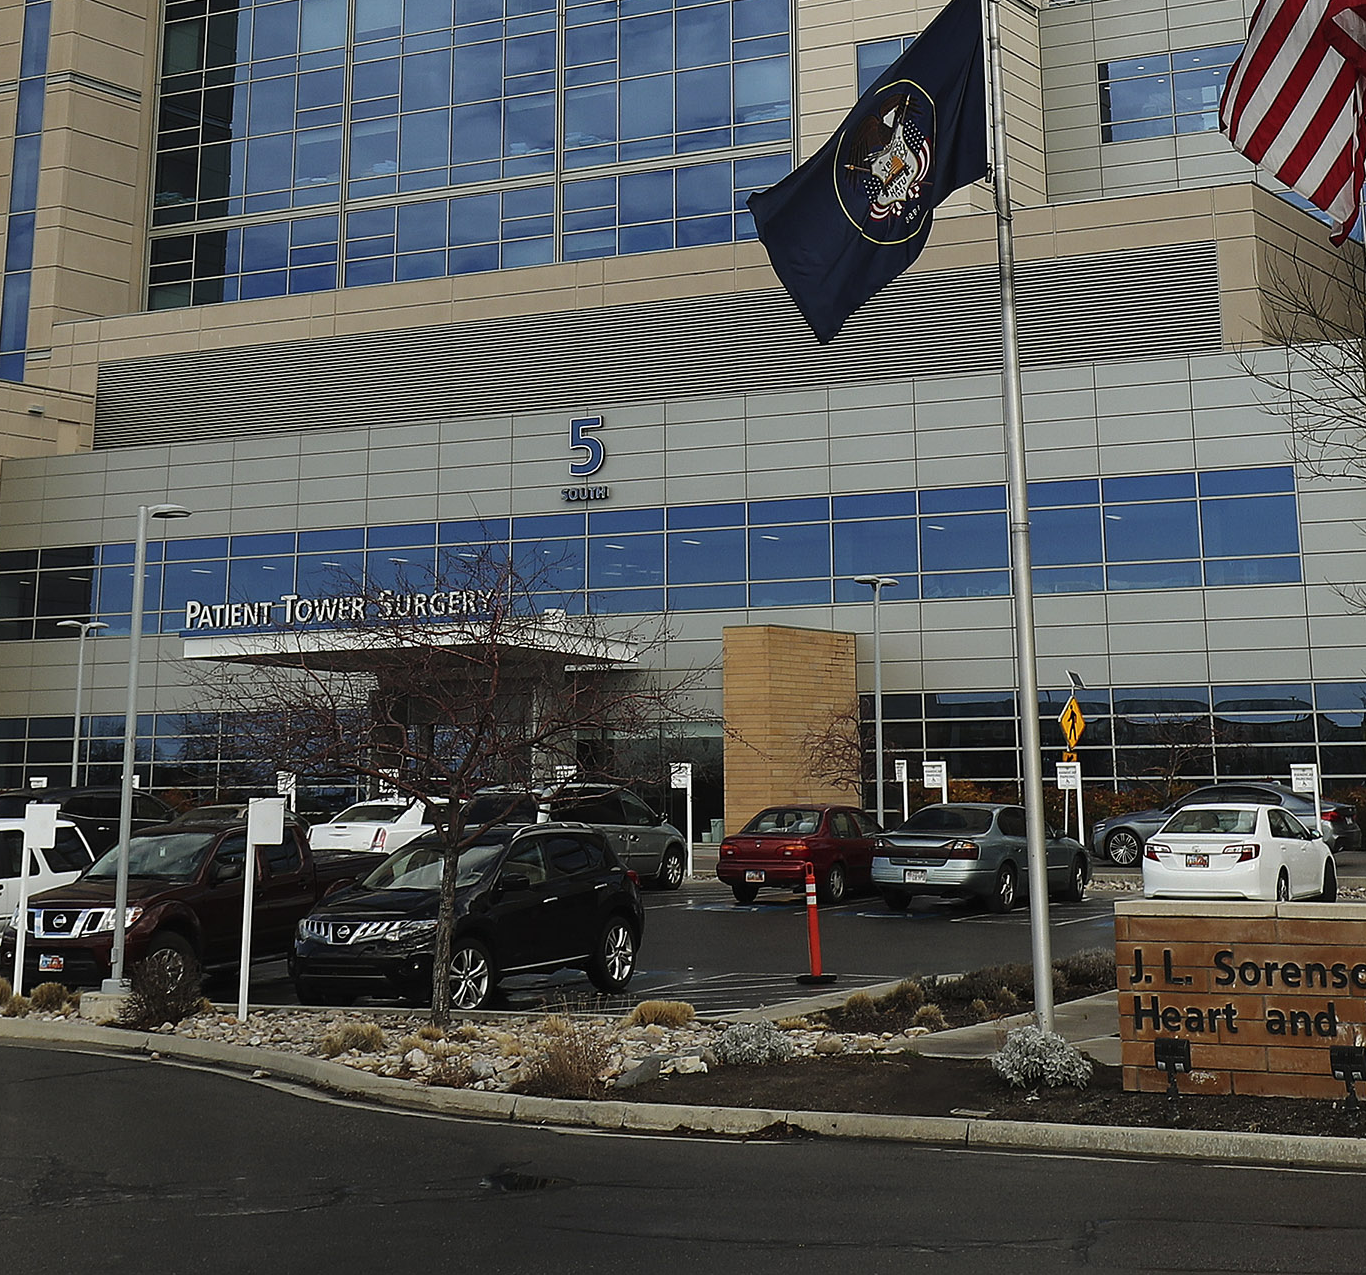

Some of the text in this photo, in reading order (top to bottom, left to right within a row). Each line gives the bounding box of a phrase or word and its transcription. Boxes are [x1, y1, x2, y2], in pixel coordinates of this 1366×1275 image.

[569, 415, 605, 477] 5
[561, 485, 610, 501] SOUTH
[185, 589, 496, 629] PATIENT TOWER SURGERY
[1130, 948, 1152, 984] J.
[1163, 949, 1193, 986] L.
[1133, 995, 1238, 1034] Heart
[1266, 1001, 1337, 1038] and
